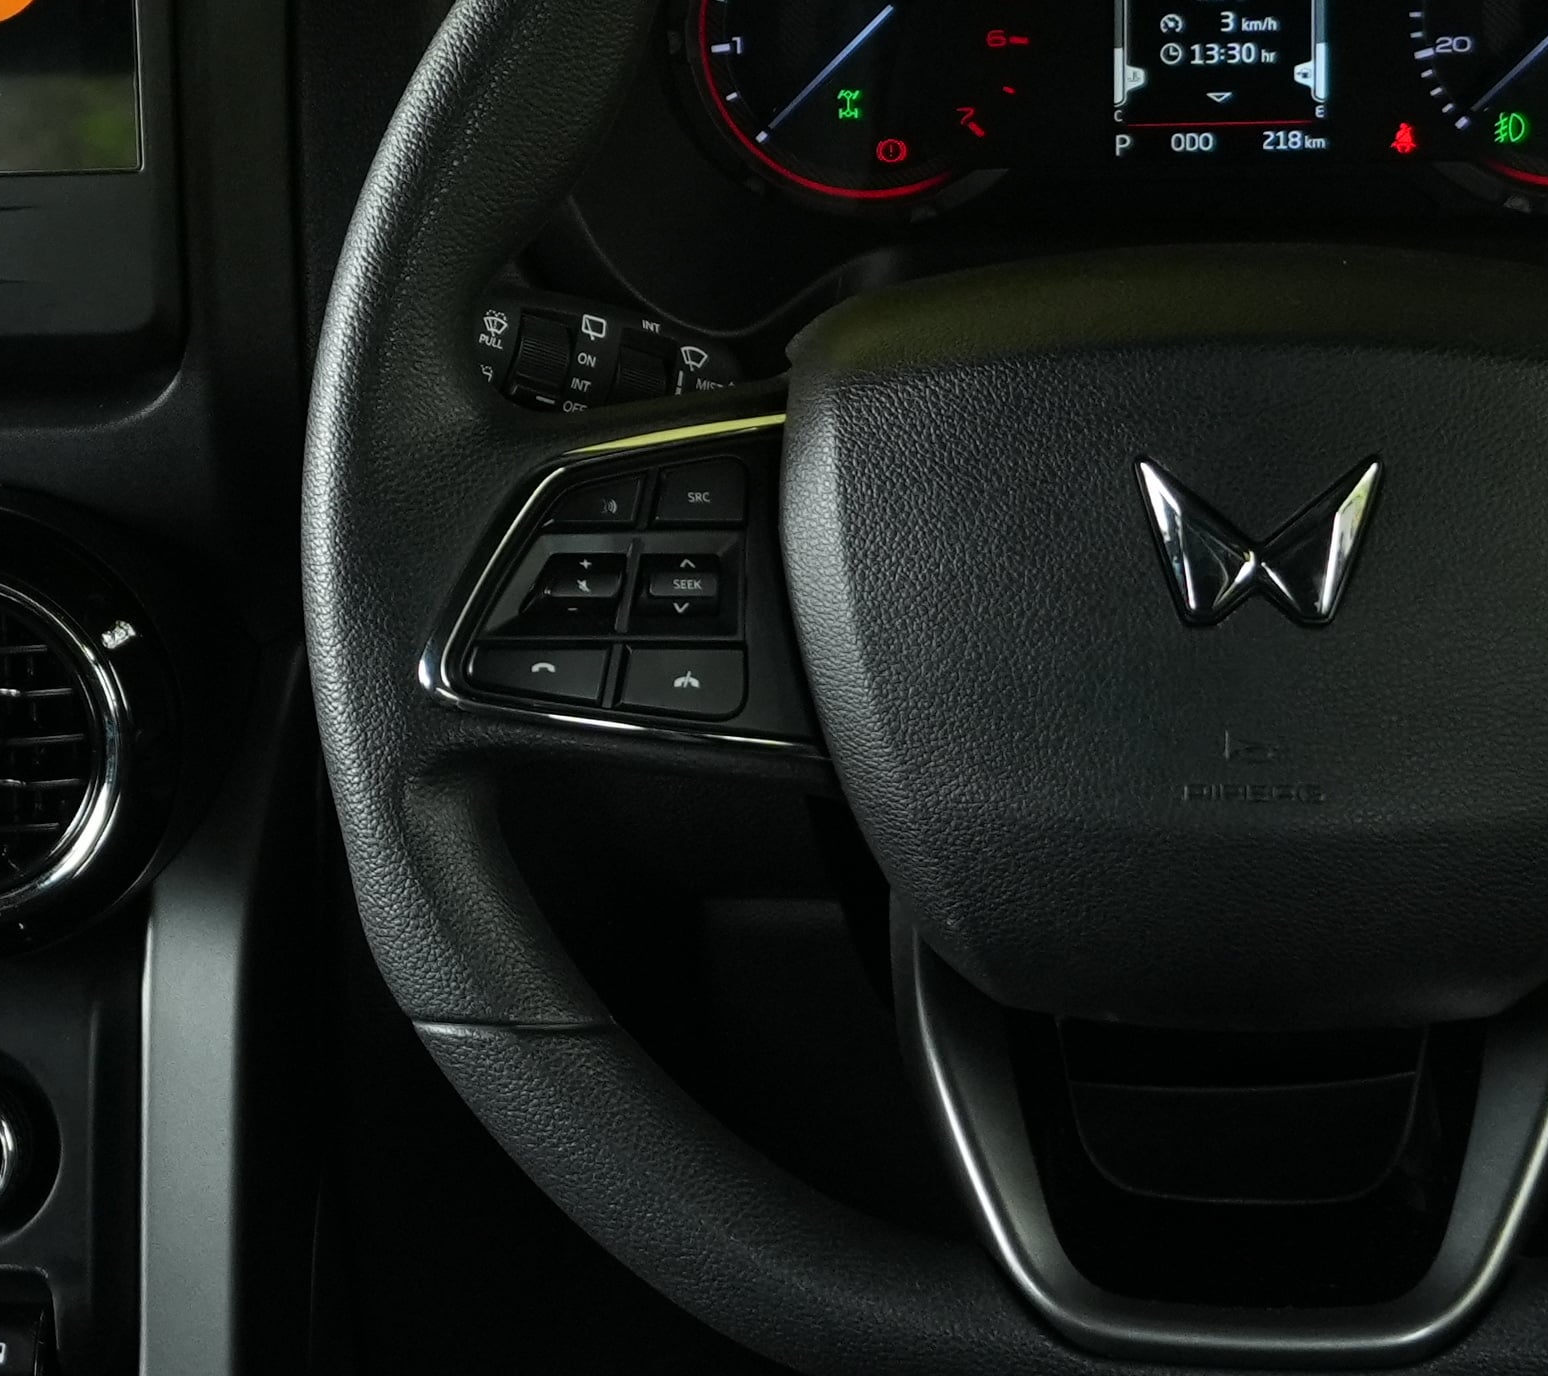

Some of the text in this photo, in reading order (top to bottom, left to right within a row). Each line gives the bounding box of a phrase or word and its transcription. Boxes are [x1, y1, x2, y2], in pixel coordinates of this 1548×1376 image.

[1220, 12, 1277, 32] 3 km/h
[731, 36, 743, 55] 1
[986, 30, 1007, 47] 6
[1435, 36, 1472, 53] 20
[1189, 43, 1277, 64] 13:30 hr
[956, 107, 975, 124] 7
[1113, 109, 1124, 122] C
[1315, 106, 1326, 119] E
[1115, 131, 1326, 156] P ODO 218 km
[642, 319, 661, 334] INT
[478, 332, 503, 350] PULL
[577, 352, 597, 368] ON
[570, 377, 592, 393] INT
[687, 491, 711, 503] SRC
[673, 578, 702, 591] SEEK
